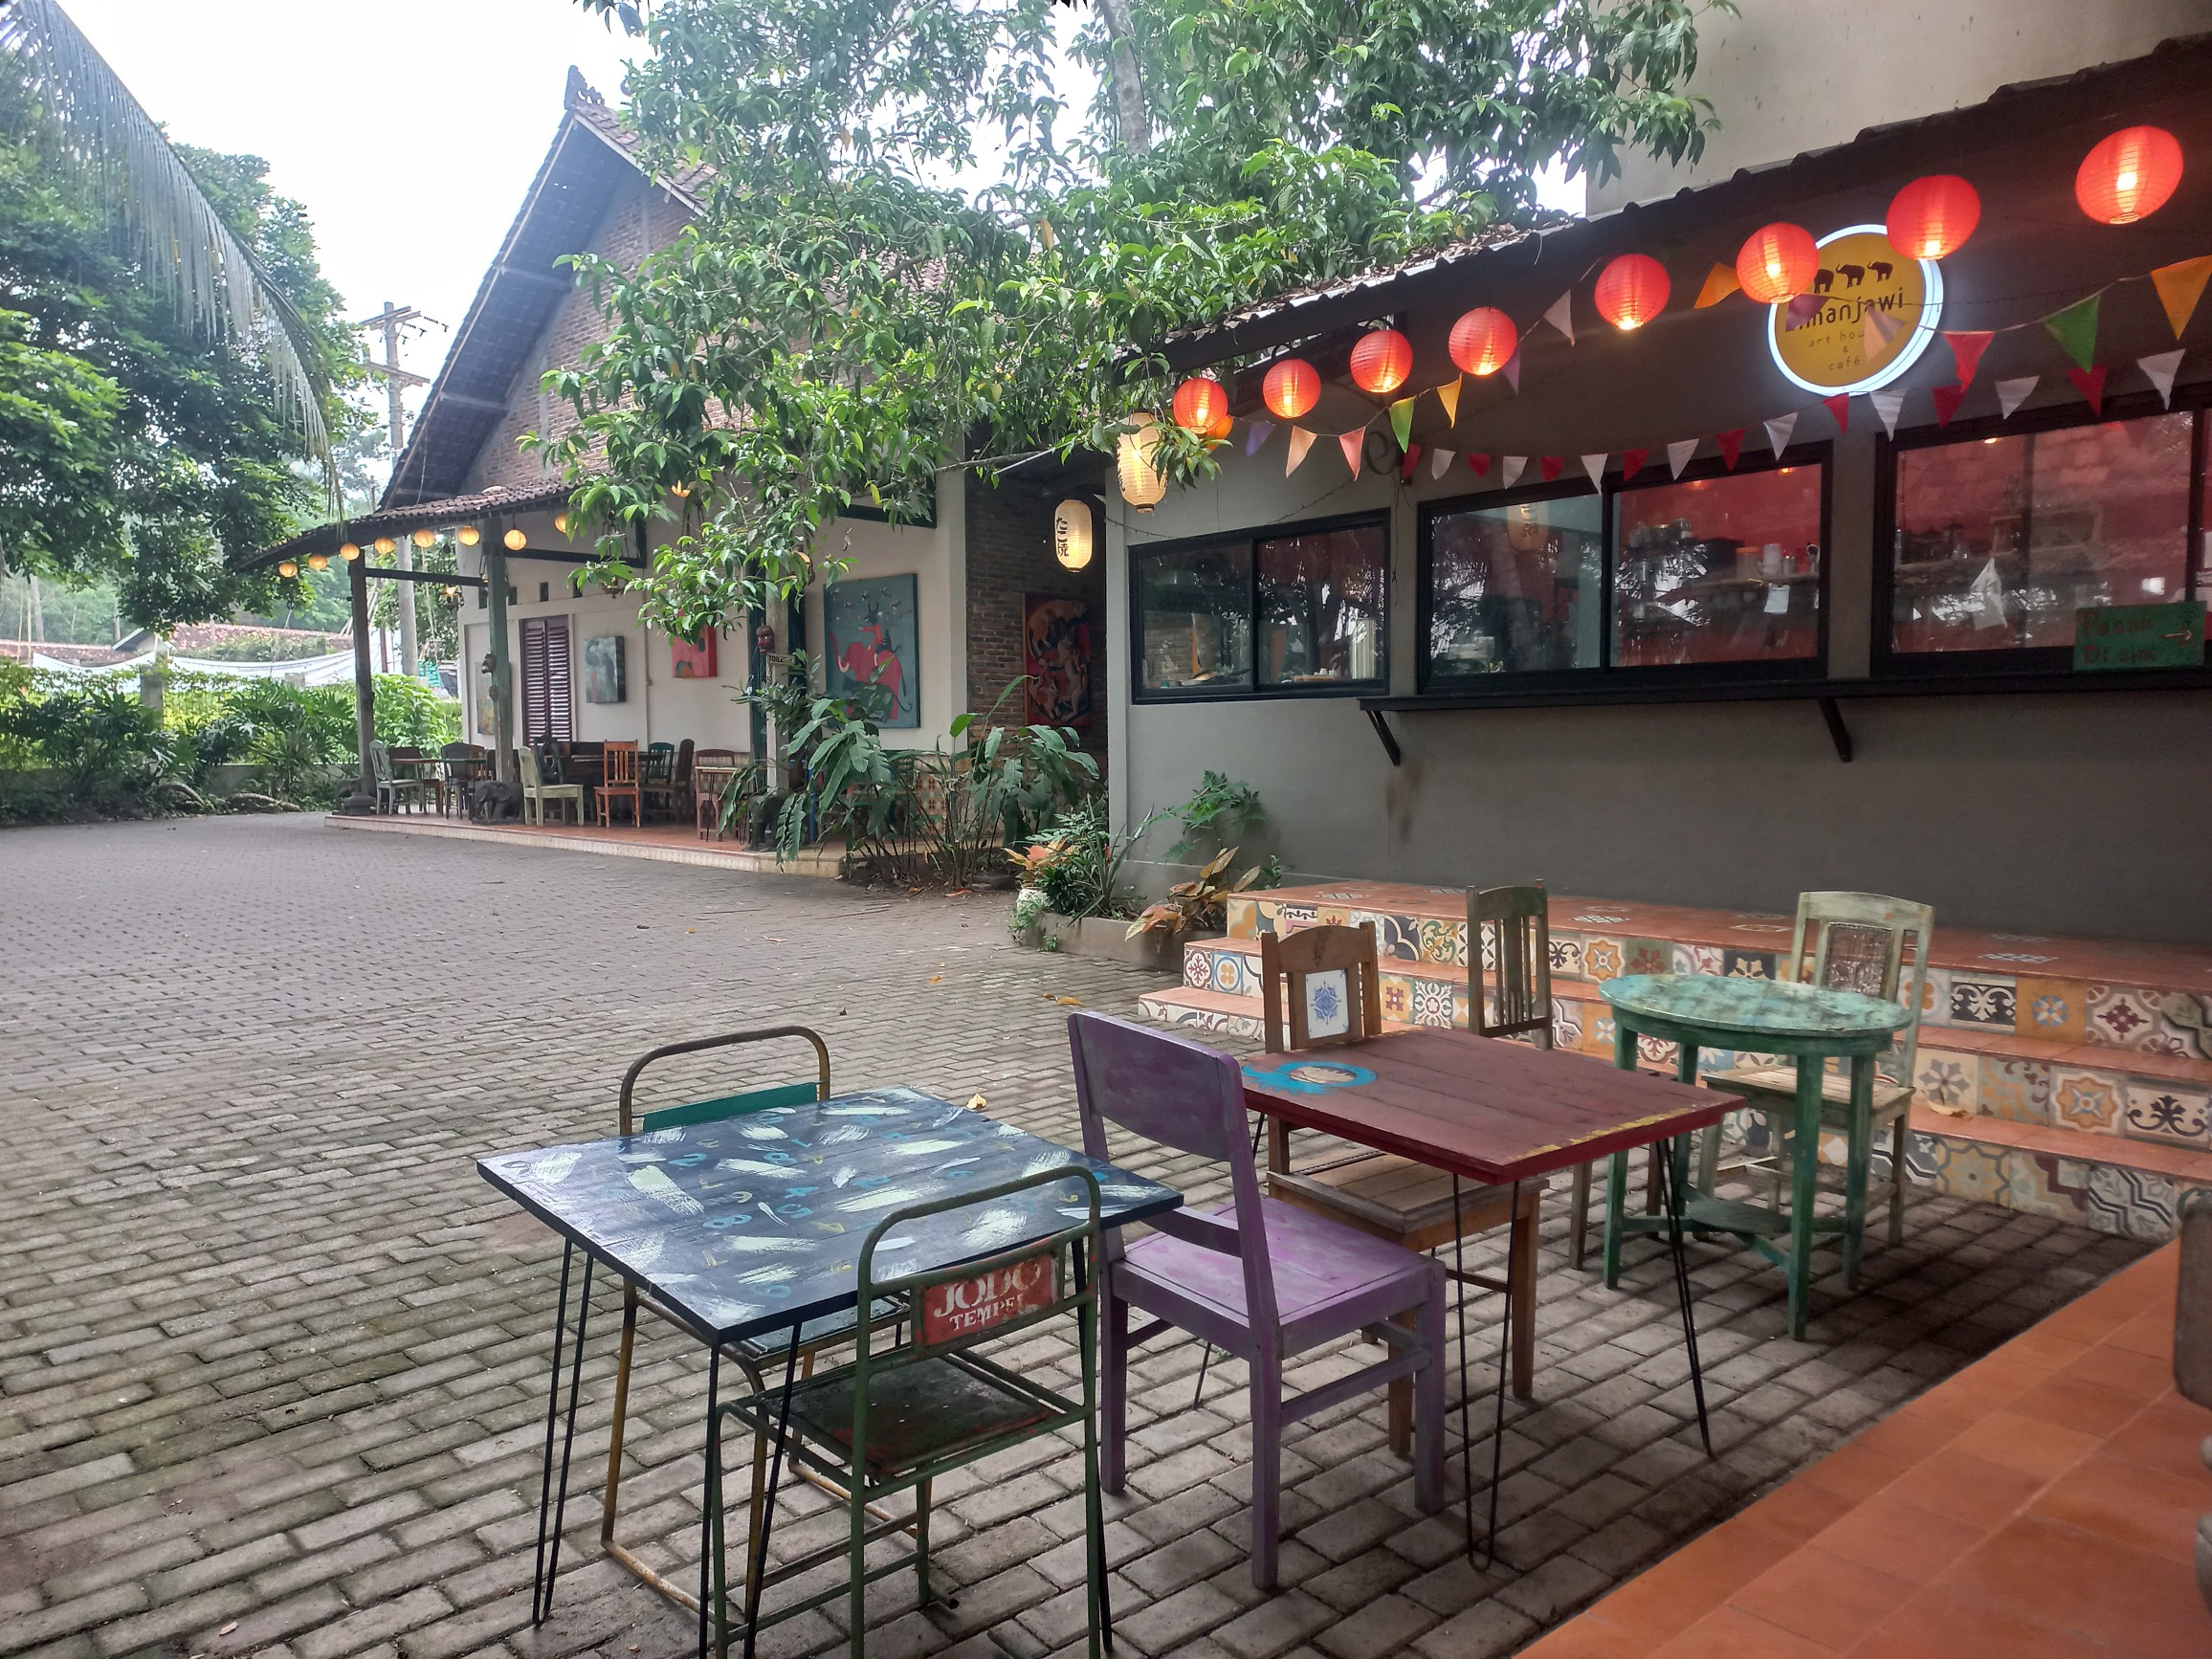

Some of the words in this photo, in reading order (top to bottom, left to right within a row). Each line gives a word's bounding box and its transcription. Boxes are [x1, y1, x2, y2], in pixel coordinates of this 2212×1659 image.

[1799, 286, 1903, 330] manjawi
[1808, 335, 1830, 348] art
[1839, 330, 1866, 342] hou
[1842, 344, 1849, 354] &
